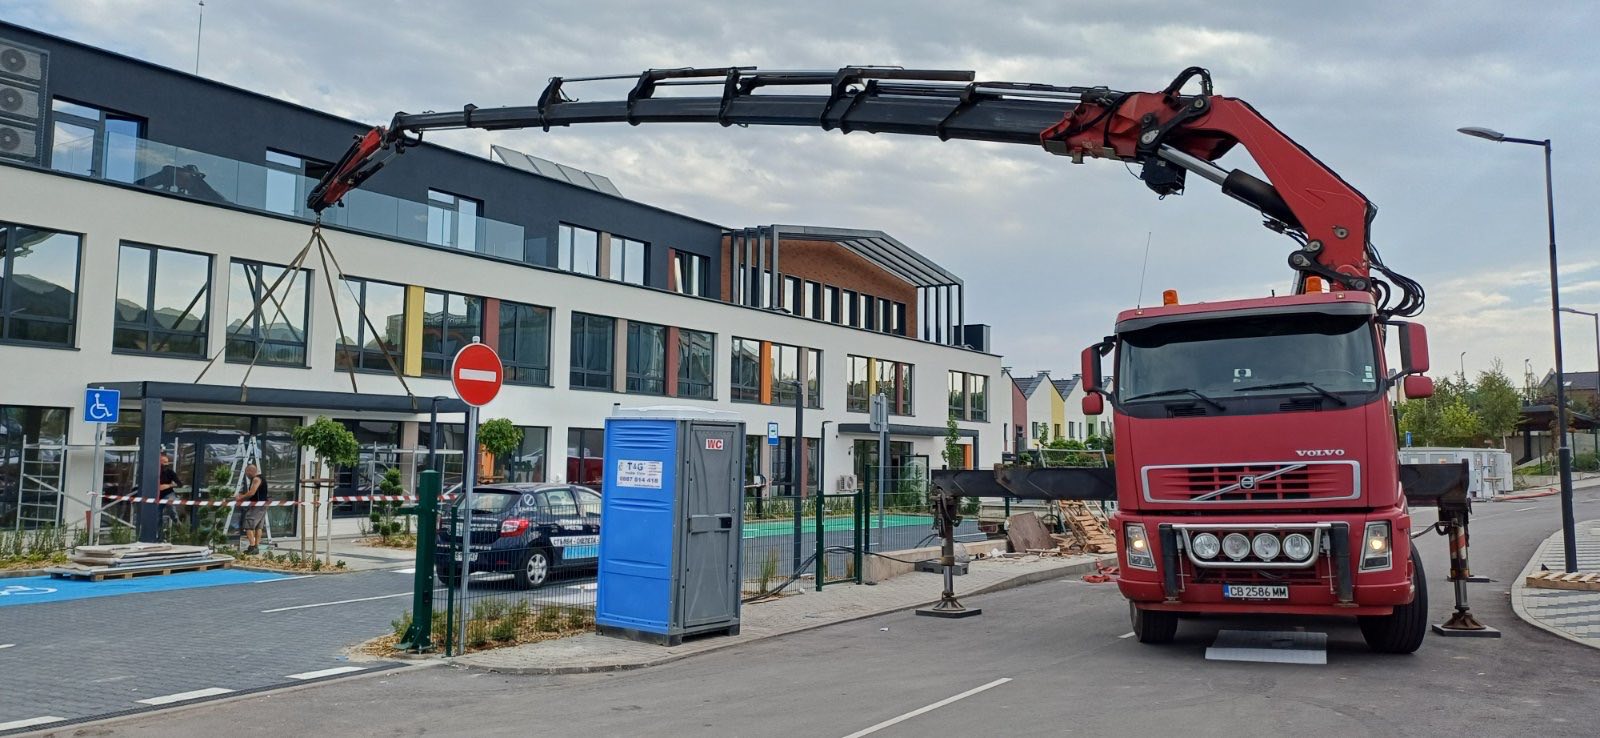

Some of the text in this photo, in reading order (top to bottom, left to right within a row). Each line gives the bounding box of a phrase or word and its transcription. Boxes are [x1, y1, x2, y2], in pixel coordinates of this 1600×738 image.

[707, 439, 722, 449] WC
[1295, 449, 1345, 457] VOLVO
[1245, 587, 1271, 597] 2586
[1272, 587, 1287, 597] MM
